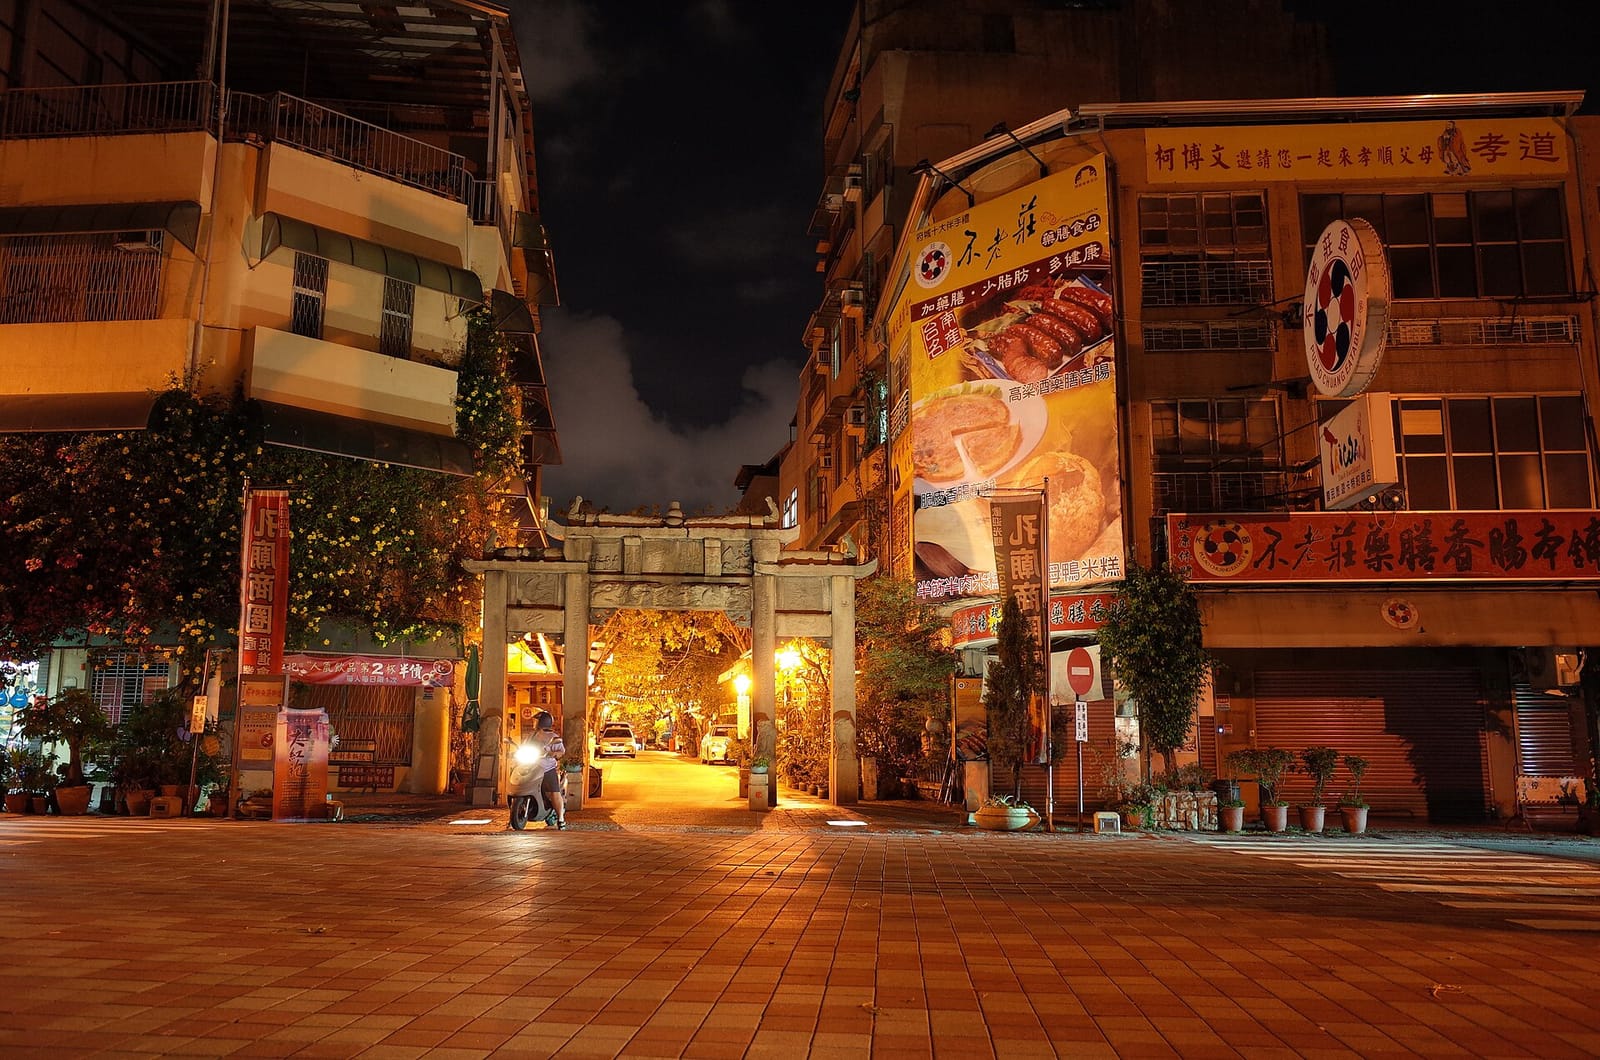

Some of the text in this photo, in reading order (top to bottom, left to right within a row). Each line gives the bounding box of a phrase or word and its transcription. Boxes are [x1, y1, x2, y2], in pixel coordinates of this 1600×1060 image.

[1470, 131, 1561, 163] 孝道
[956, 194, 1038, 270] 不老莊
[1041, 214, 1101, 248] 藥膳食品
